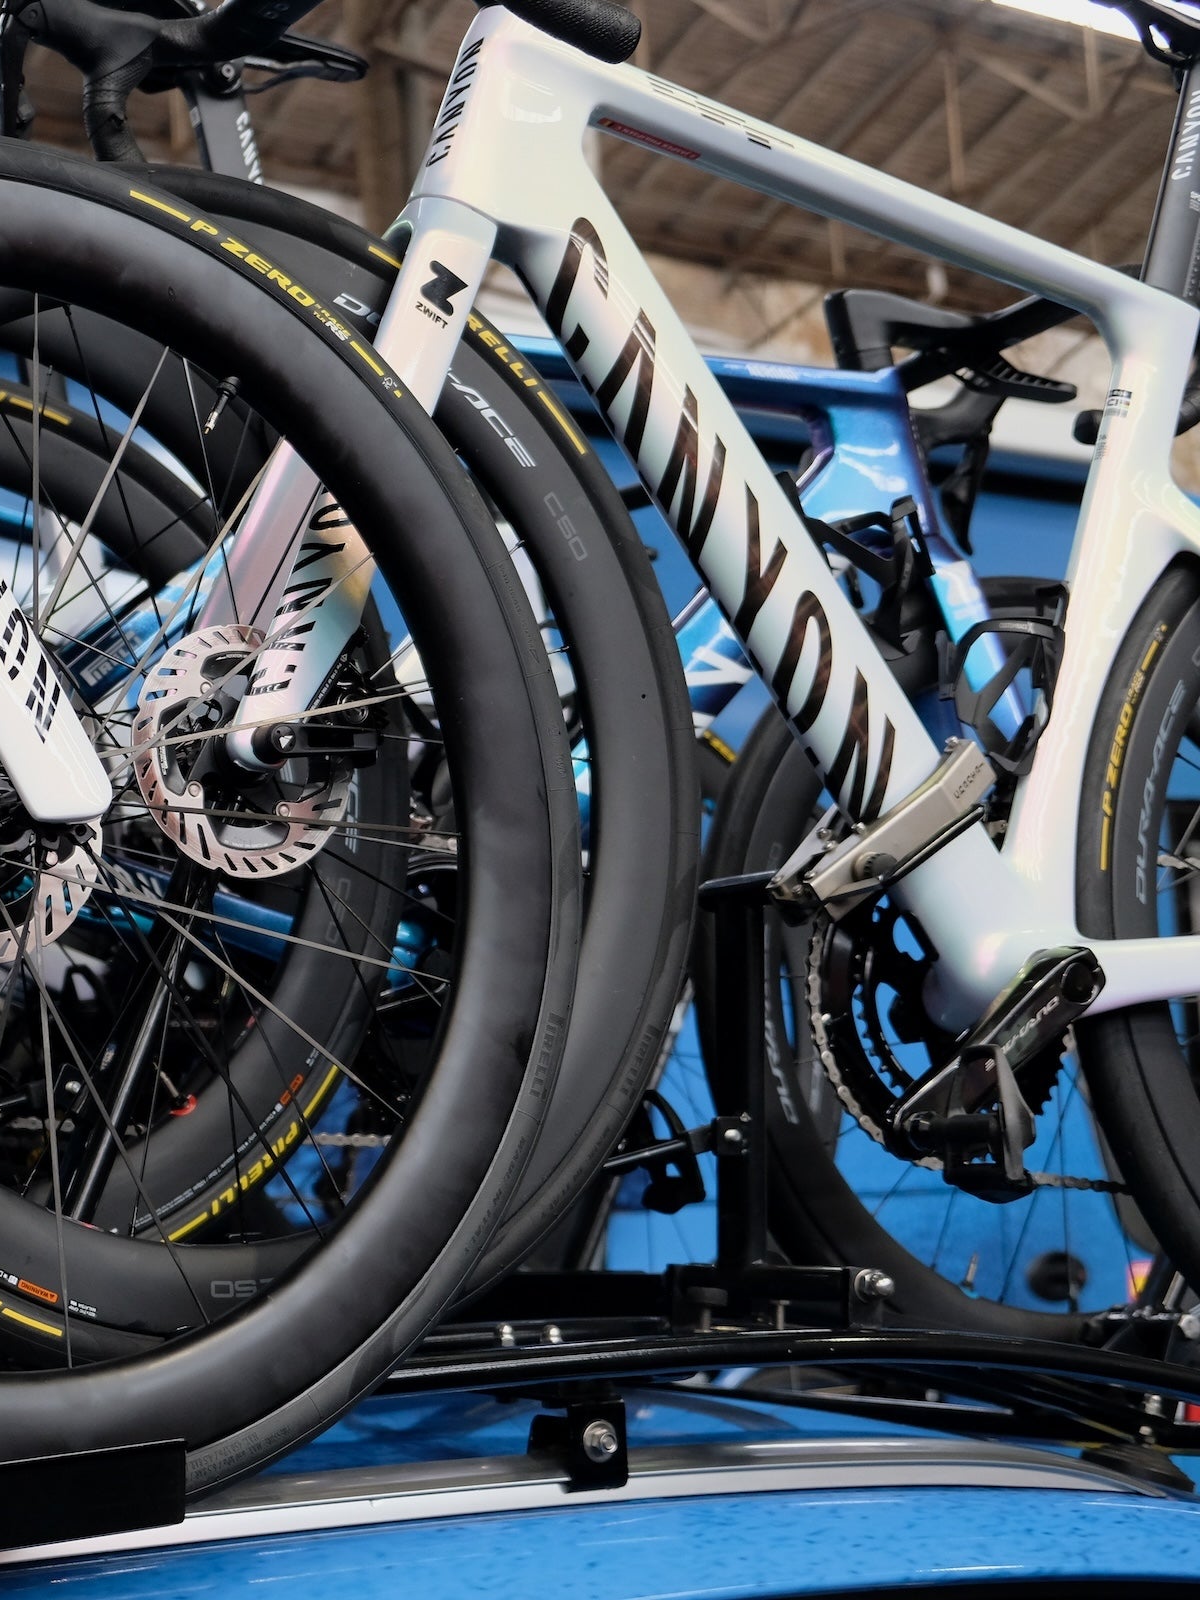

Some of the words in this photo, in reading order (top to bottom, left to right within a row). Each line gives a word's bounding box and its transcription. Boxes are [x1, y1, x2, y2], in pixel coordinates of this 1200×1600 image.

[425, 37, 484, 168] CANYON
[190, 220, 218, 235] P
[220, 237, 315, 307] ZERO
[321, 309, 351, 337] RACE
[415, 301, 448, 329] ZWIFT
[466, 312, 537, 387] RELLI
[543, 491, 589, 562] C50
[546, 217, 895, 826] CANYON
[1106, 702, 1134, 789] ZERO
[1136, 680, 1186, 904] DURA-ACE
